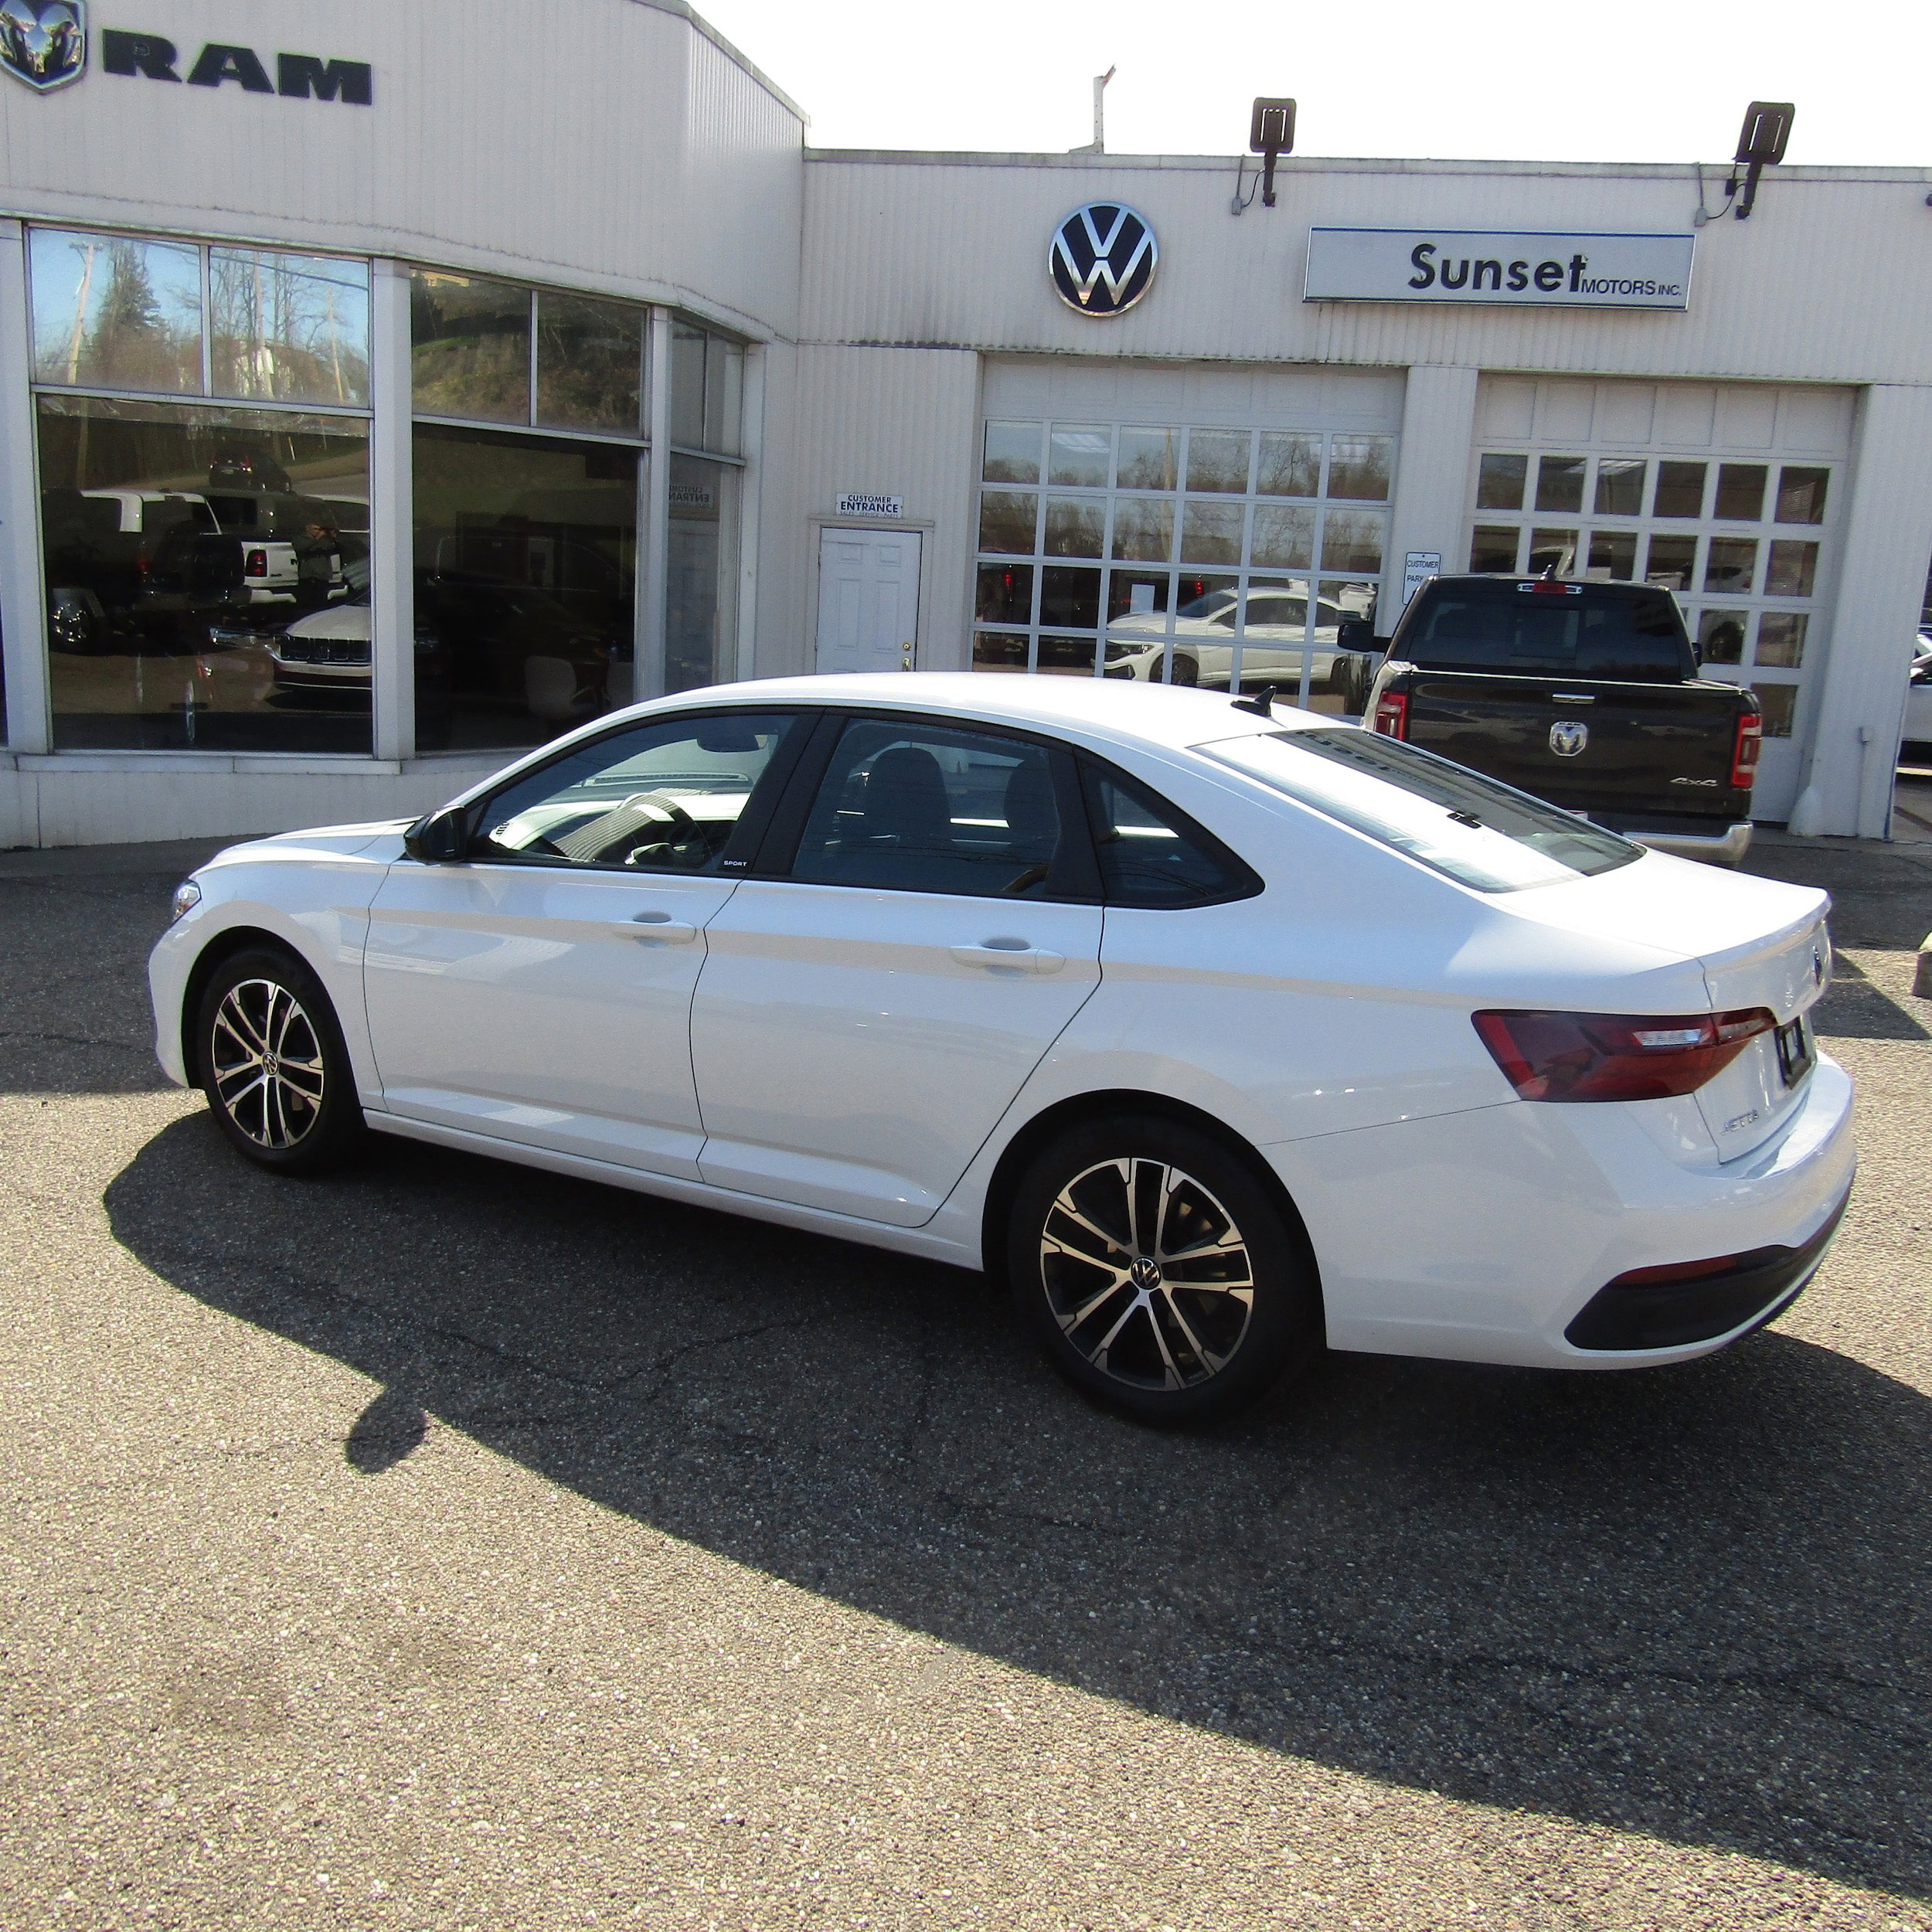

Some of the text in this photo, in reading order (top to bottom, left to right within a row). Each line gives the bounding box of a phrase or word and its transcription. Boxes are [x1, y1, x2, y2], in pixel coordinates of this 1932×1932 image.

[102, 28, 372, 106] RAM
[1050, 202, 1157, 309] VW
[1407, 243, 1682, 297] Sunset MOTORS INC.
[840, 501, 899, 513] ENTRANCE
[847, 494, 892, 504] CUSTOMER
[1406, 560, 1438, 569] CUSTOMER
[1721, 1109, 1759, 1136] JETTA
